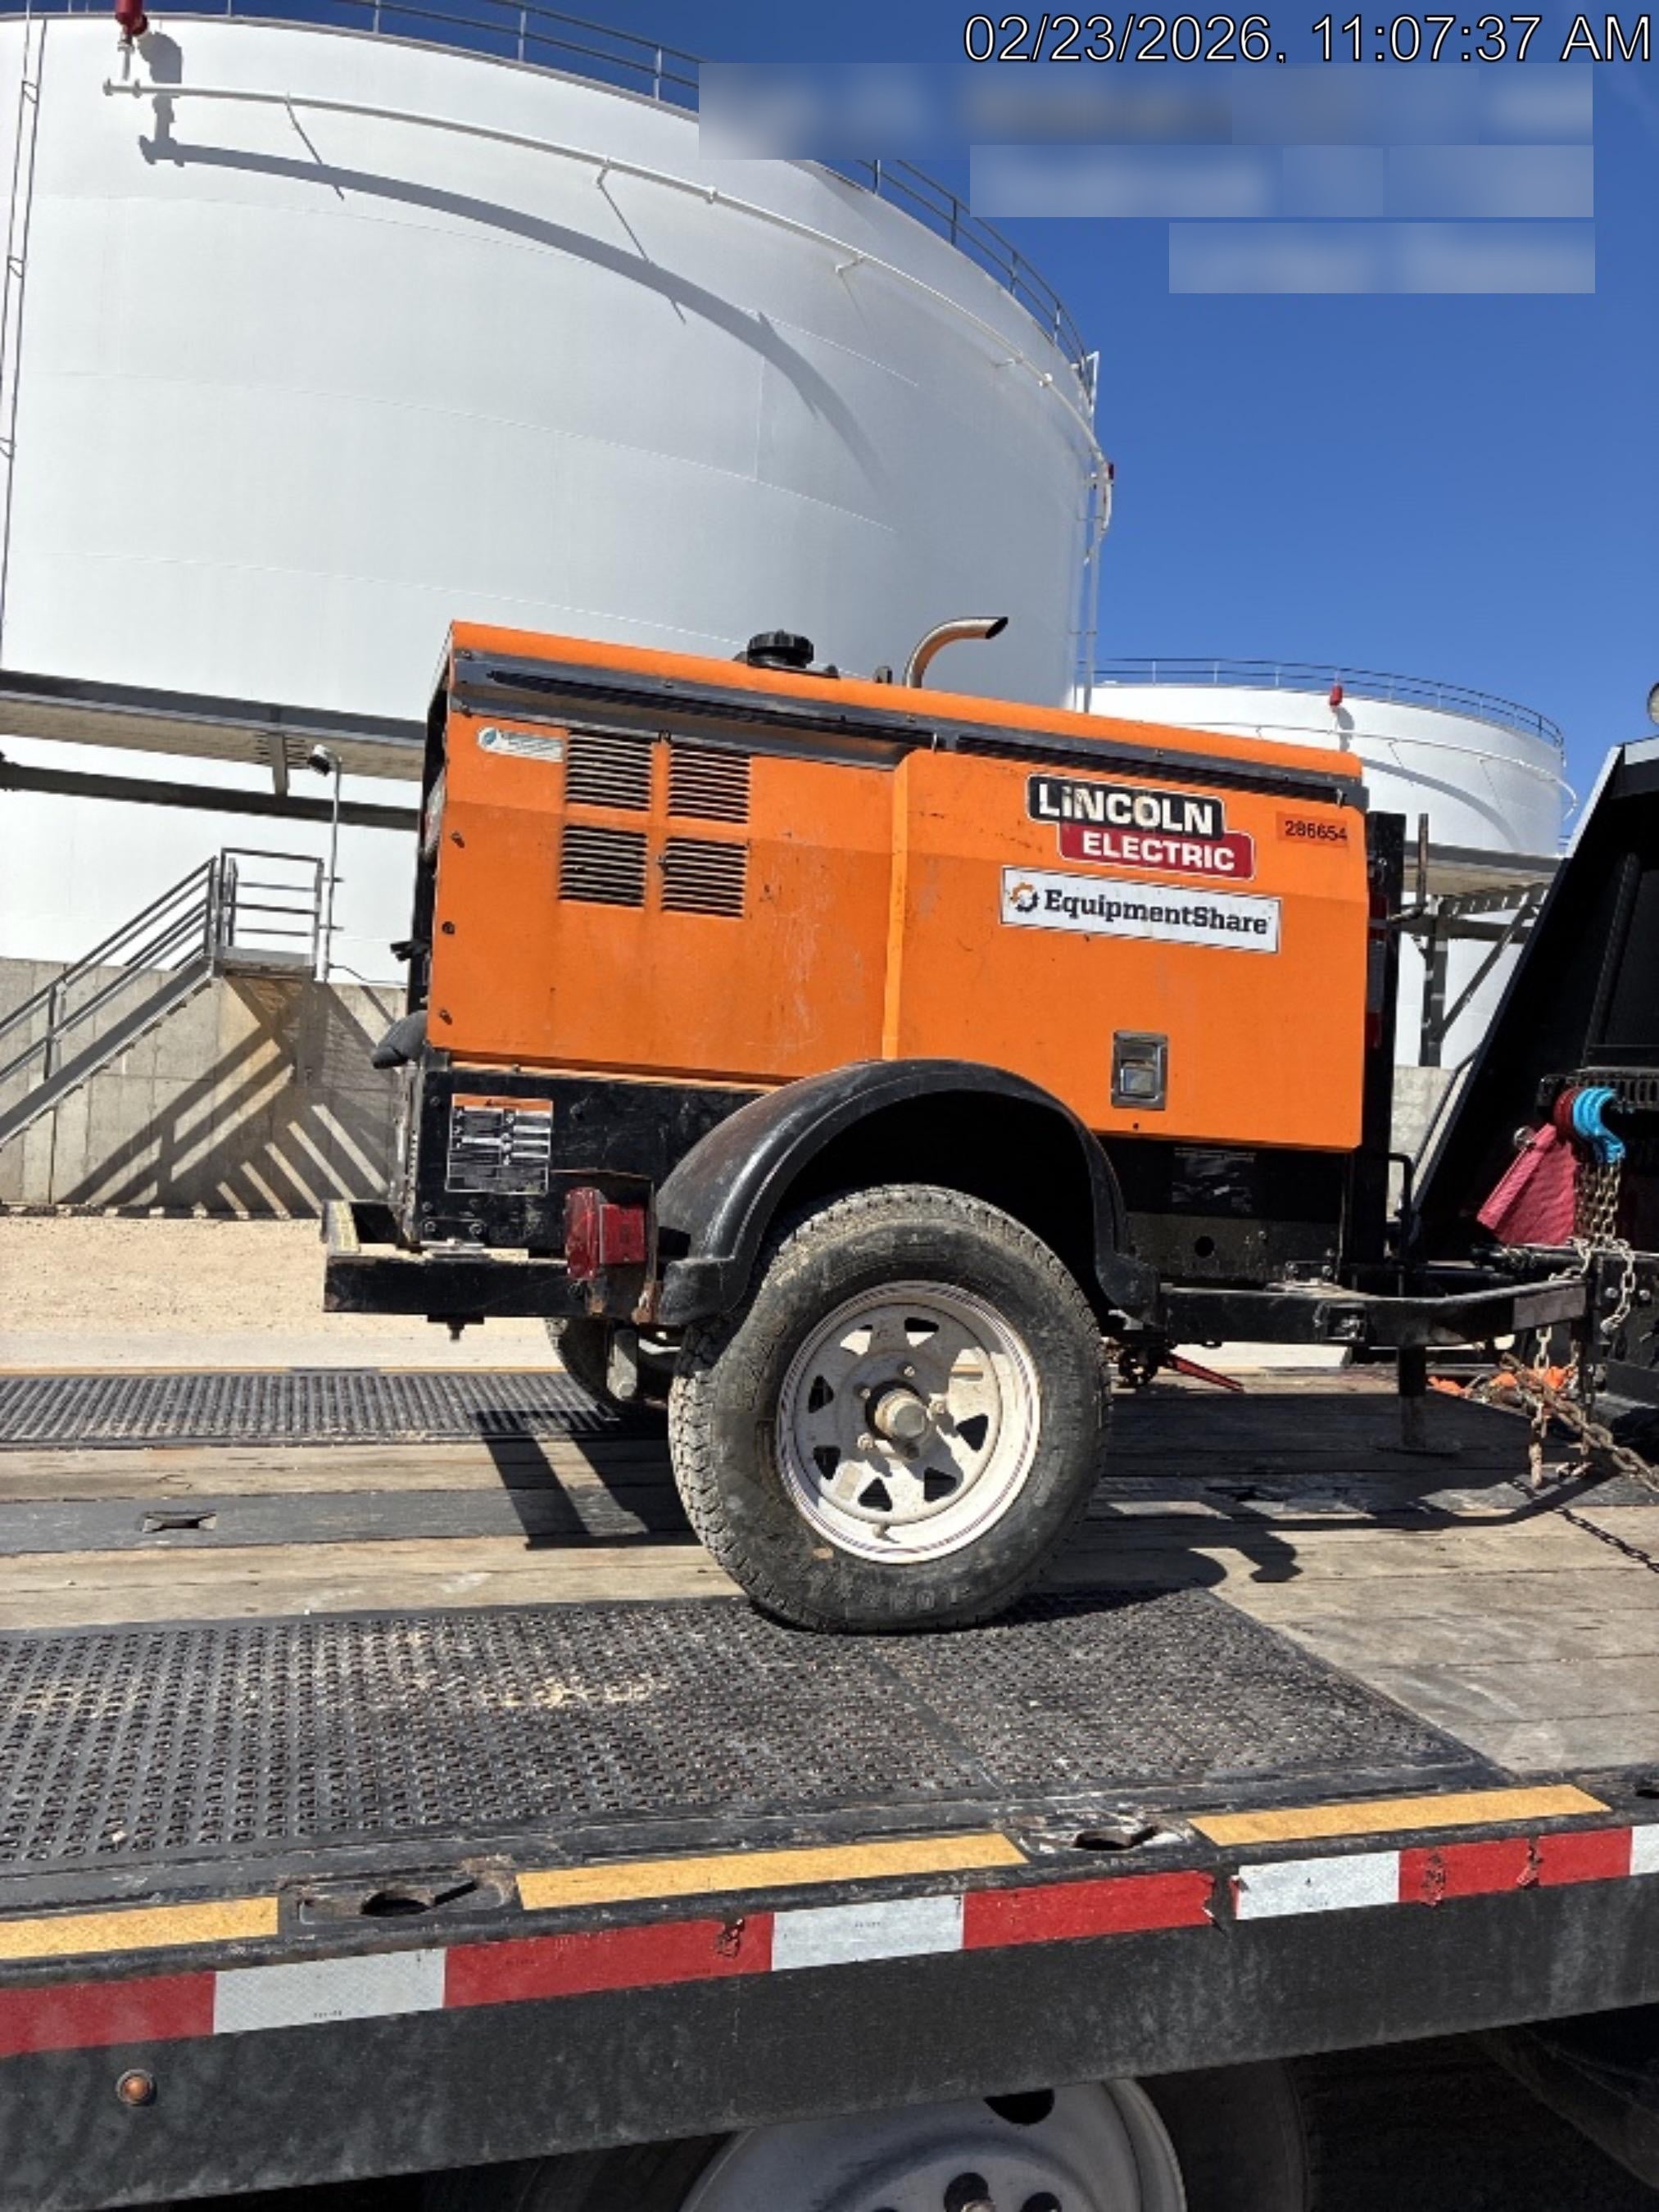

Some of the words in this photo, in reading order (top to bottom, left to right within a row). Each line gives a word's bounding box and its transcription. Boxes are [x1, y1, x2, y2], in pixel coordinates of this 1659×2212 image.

[1082, 830, 1235, 872] ELECTRIC
[1285, 820, 1348, 841] 286654
[1044, 888, 1269, 935] EquipmentShare
